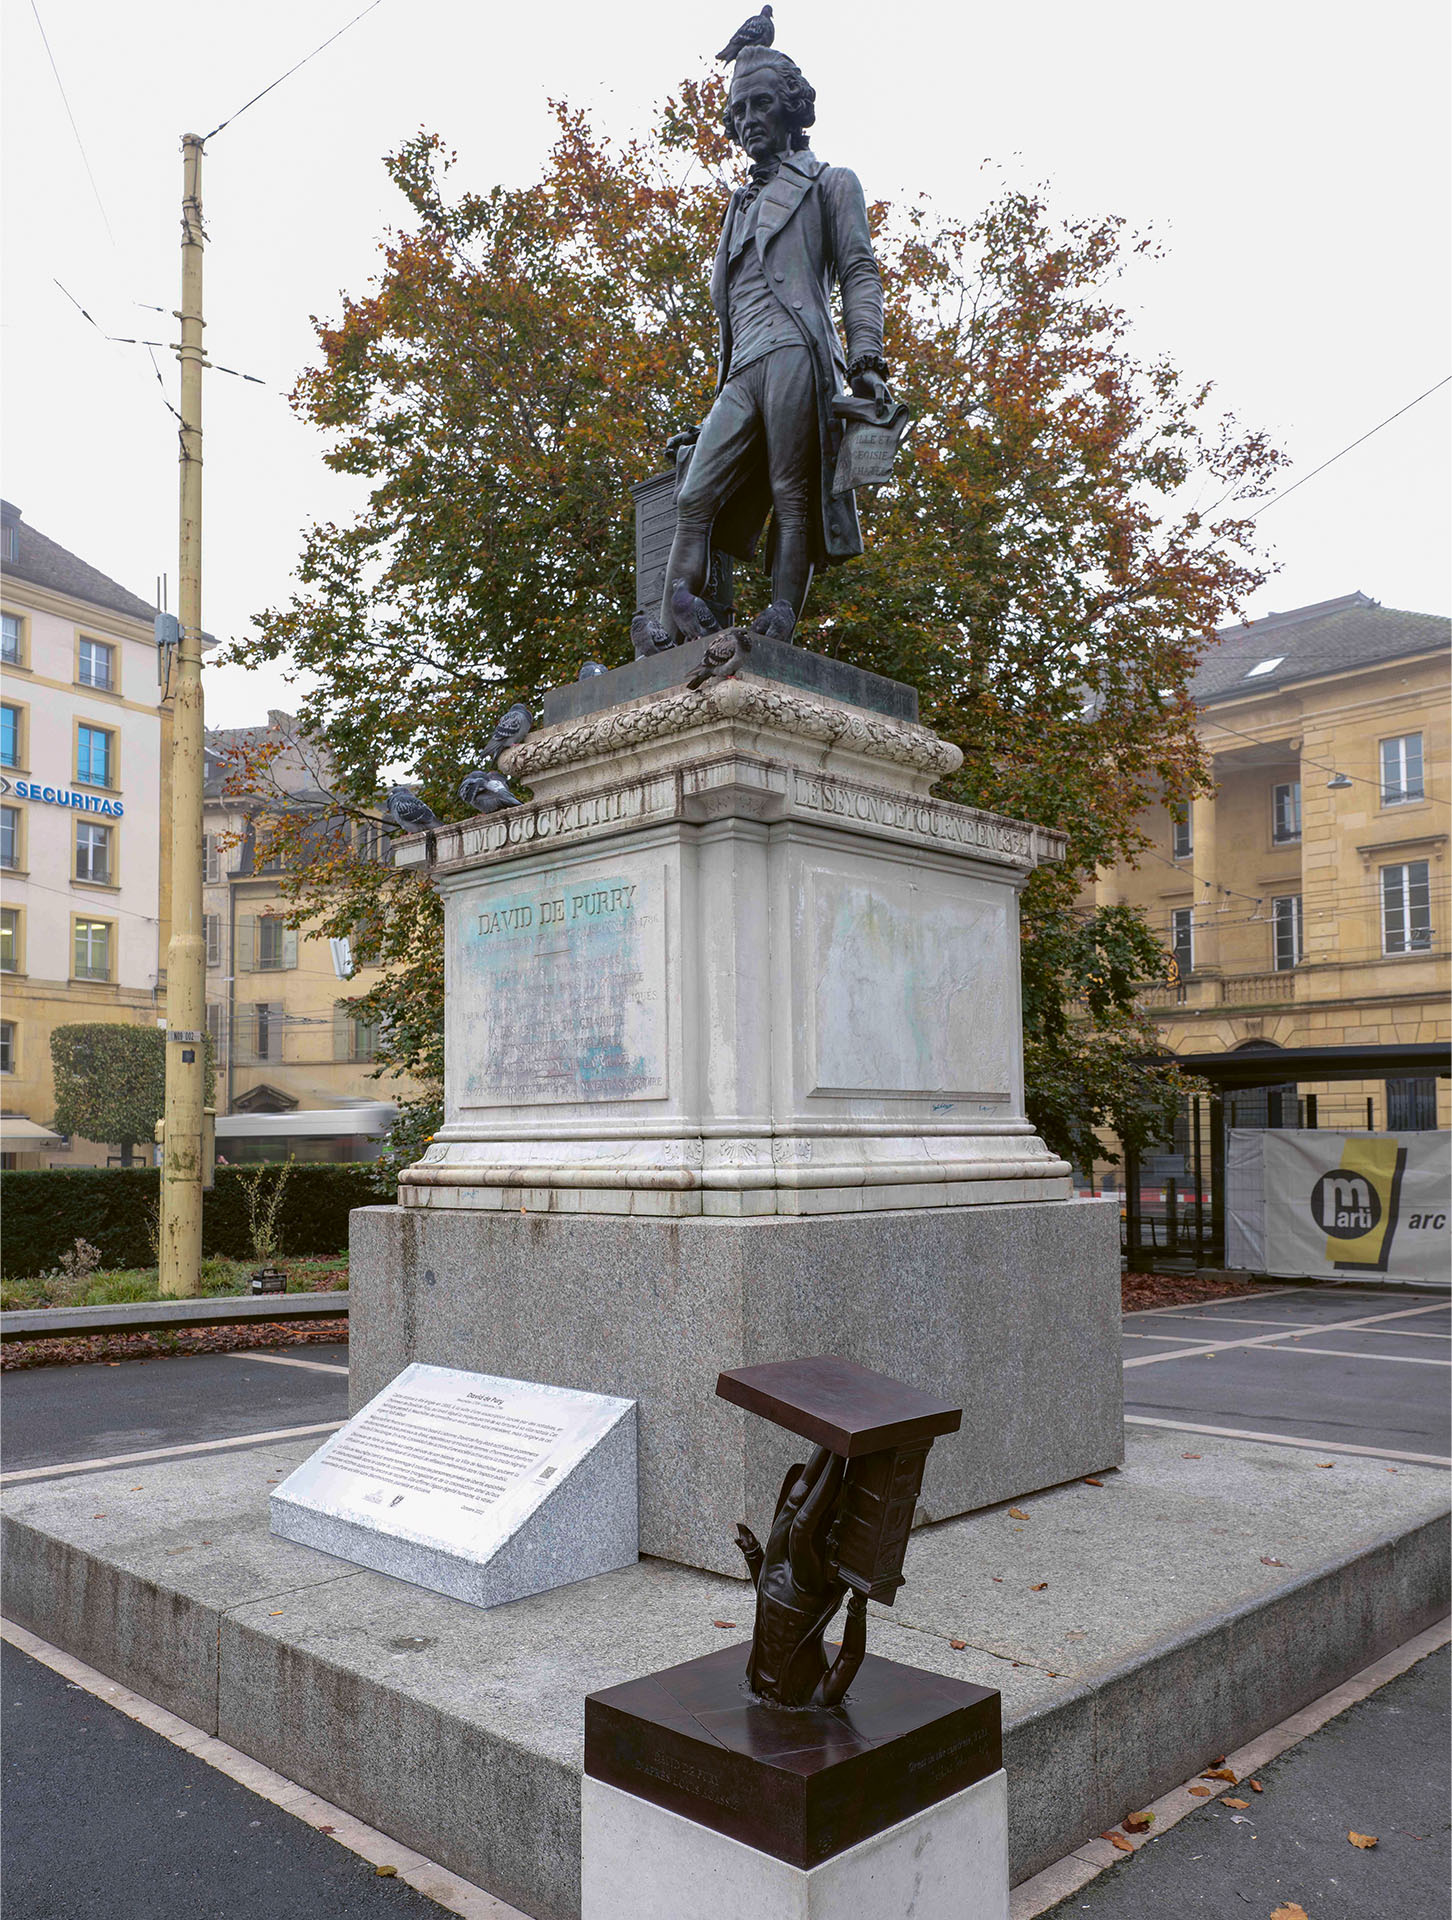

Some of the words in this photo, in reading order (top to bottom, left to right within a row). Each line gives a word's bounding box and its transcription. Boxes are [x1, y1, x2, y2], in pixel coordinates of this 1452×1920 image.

[15, 781, 124, 817] SECURITAS
[794, 777, 820, 811] LE
[822, 785, 881, 823] SEYON
[976, 822, 998, 850] EN
[478, 906, 532, 936] DAVID
[539, 900, 565, 925] DE
[571, 885, 637, 919] PURRY
[1322, 1177, 1372, 1229] marti
[1408, 1213, 1447, 1231] arc
[466, 1392, 485, 1401] David
